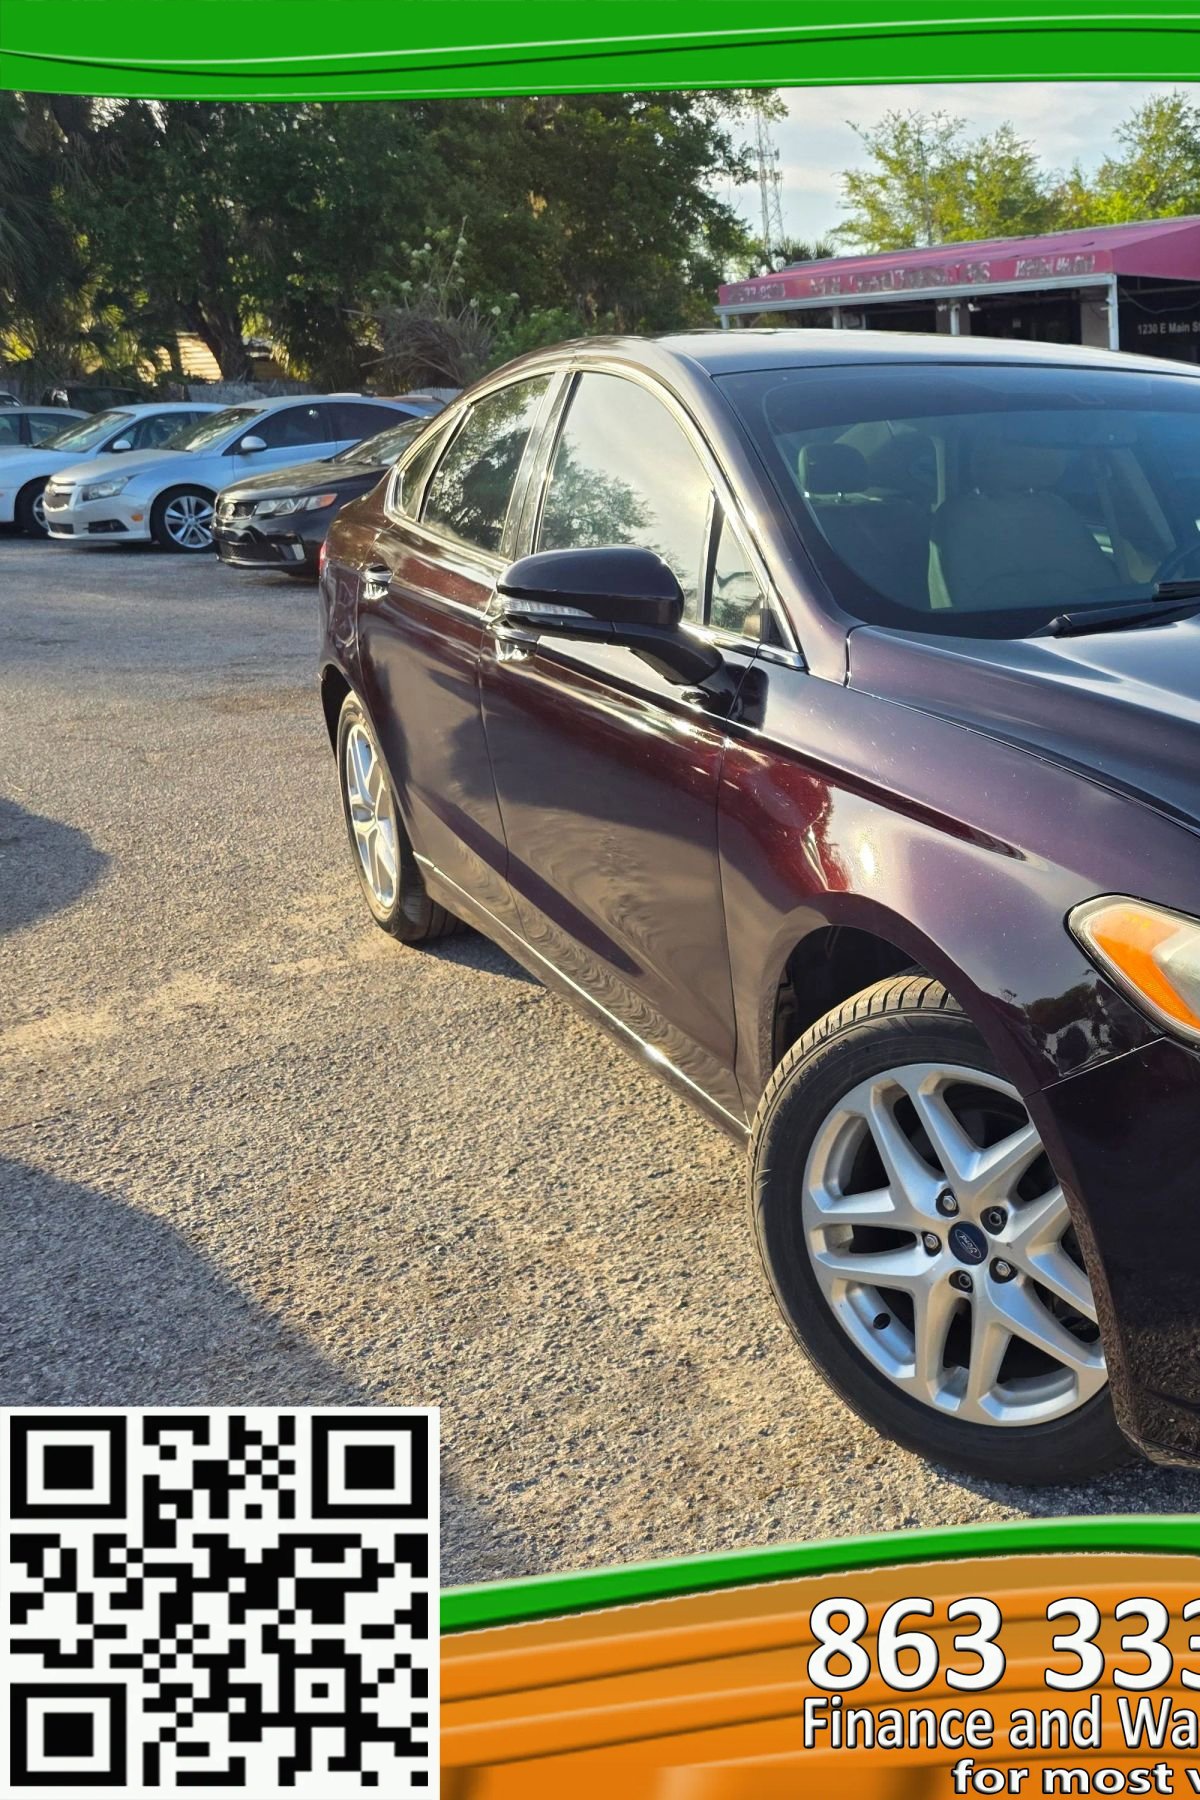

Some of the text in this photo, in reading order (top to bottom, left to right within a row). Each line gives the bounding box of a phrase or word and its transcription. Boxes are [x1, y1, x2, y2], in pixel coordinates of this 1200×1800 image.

[1137, 323, 1158, 335] 1230
[1160, 322, 1166, 333] E
[1169, 322, 1190, 333] Main
